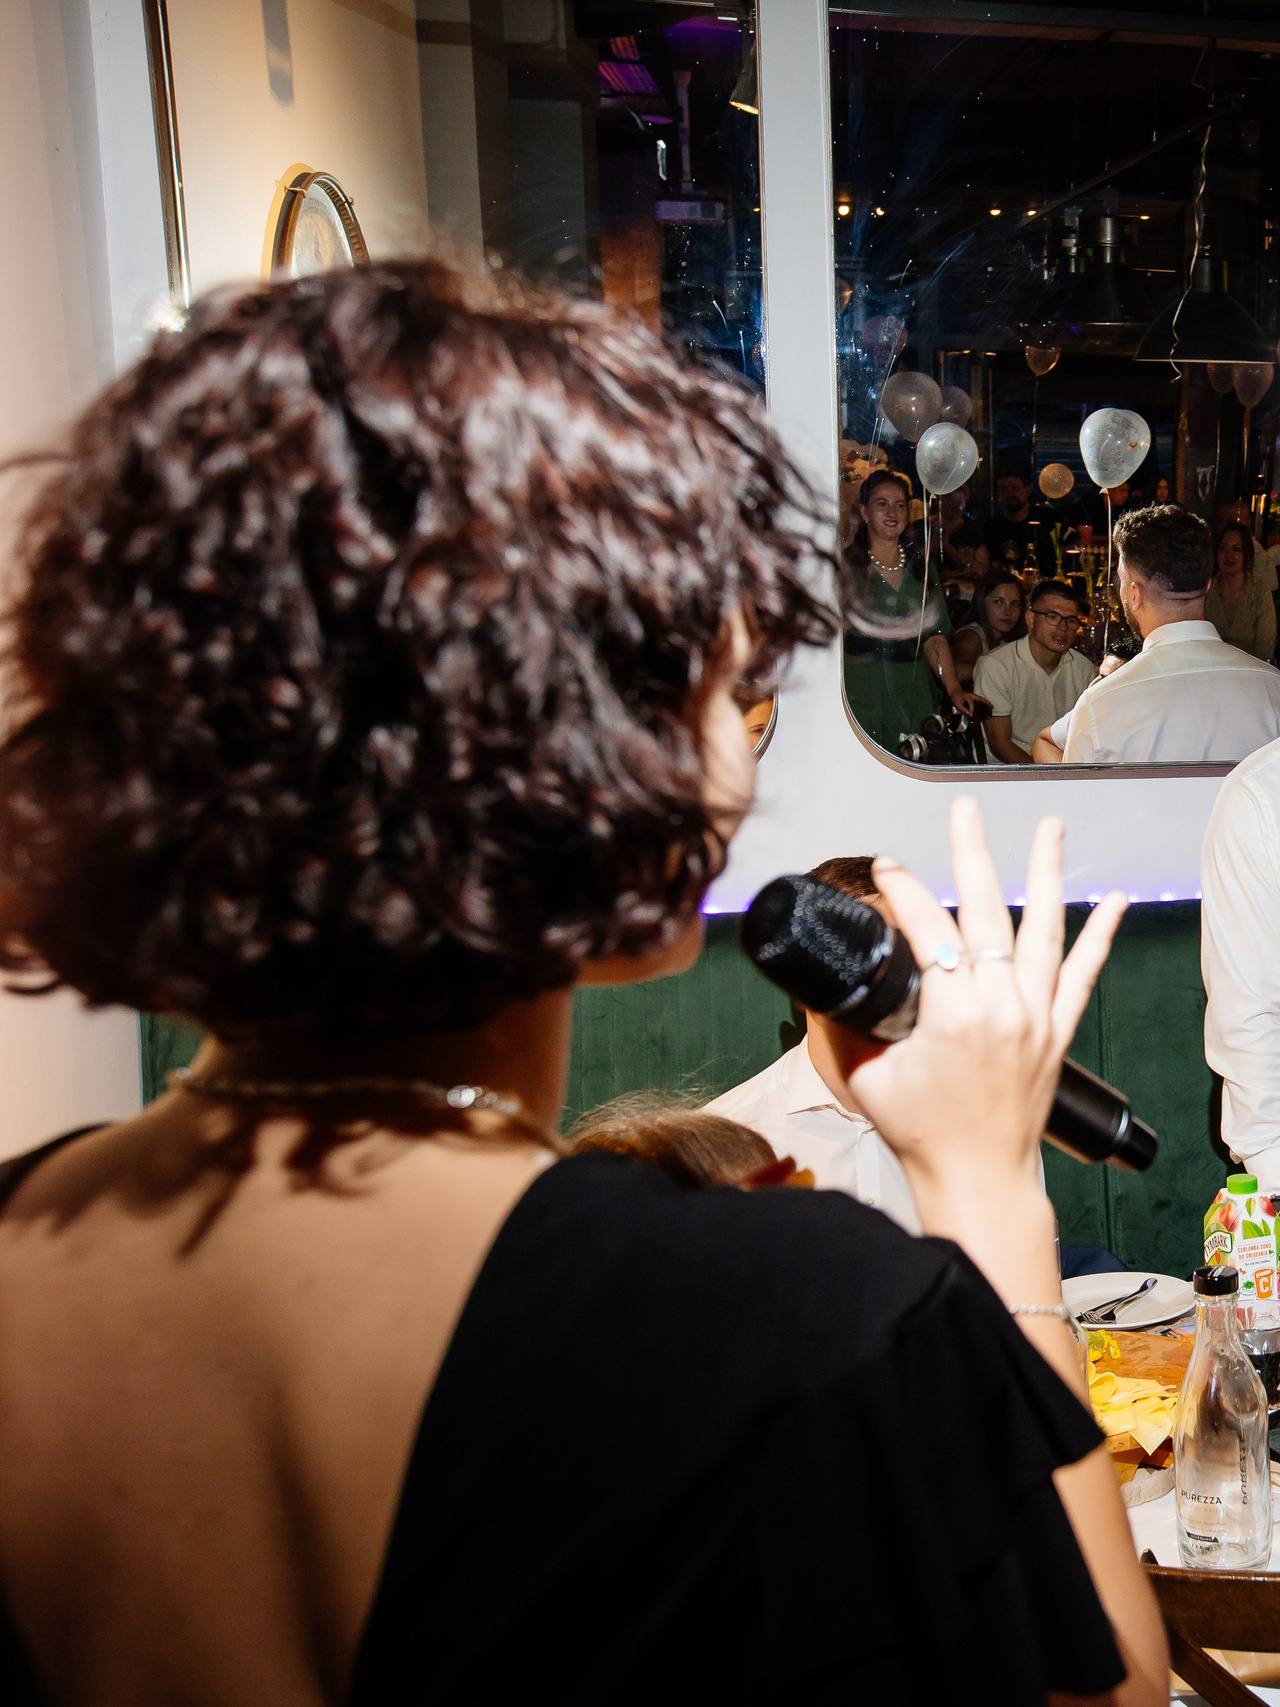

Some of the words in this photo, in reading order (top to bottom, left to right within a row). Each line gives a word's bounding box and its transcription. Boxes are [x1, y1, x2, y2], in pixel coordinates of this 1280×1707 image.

[1204, 1234, 1229, 1257] TYMBARK
[1237, 1245, 1259, 1253] SZKLANKA
[1259, 1277, 1270, 1294] C
[1181, 1489, 1222, 1505] PUREZZA
